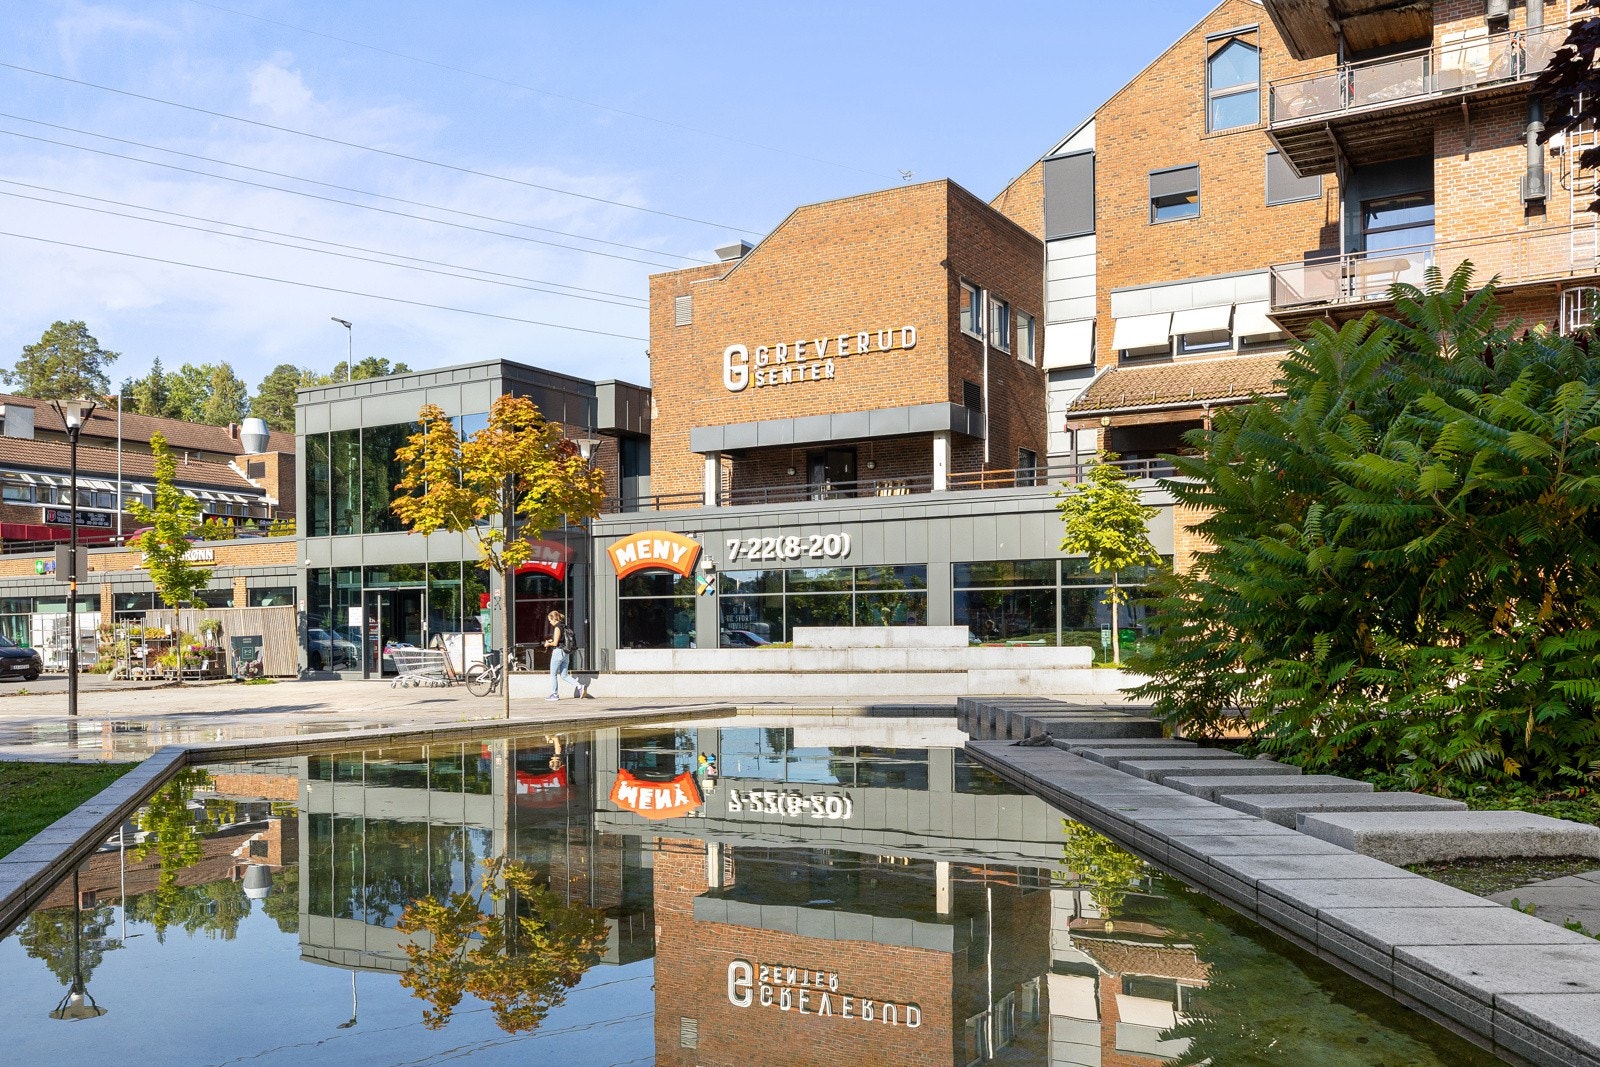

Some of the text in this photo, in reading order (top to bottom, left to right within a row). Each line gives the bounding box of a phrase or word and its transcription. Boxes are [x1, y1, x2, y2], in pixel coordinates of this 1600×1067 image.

[755, 325, 918, 367] GREVERUD
[754, 361, 836, 388] SENTER
[615, 539, 688, 567] MENY
[727, 532, 852, 561] 7-22(8-20)
